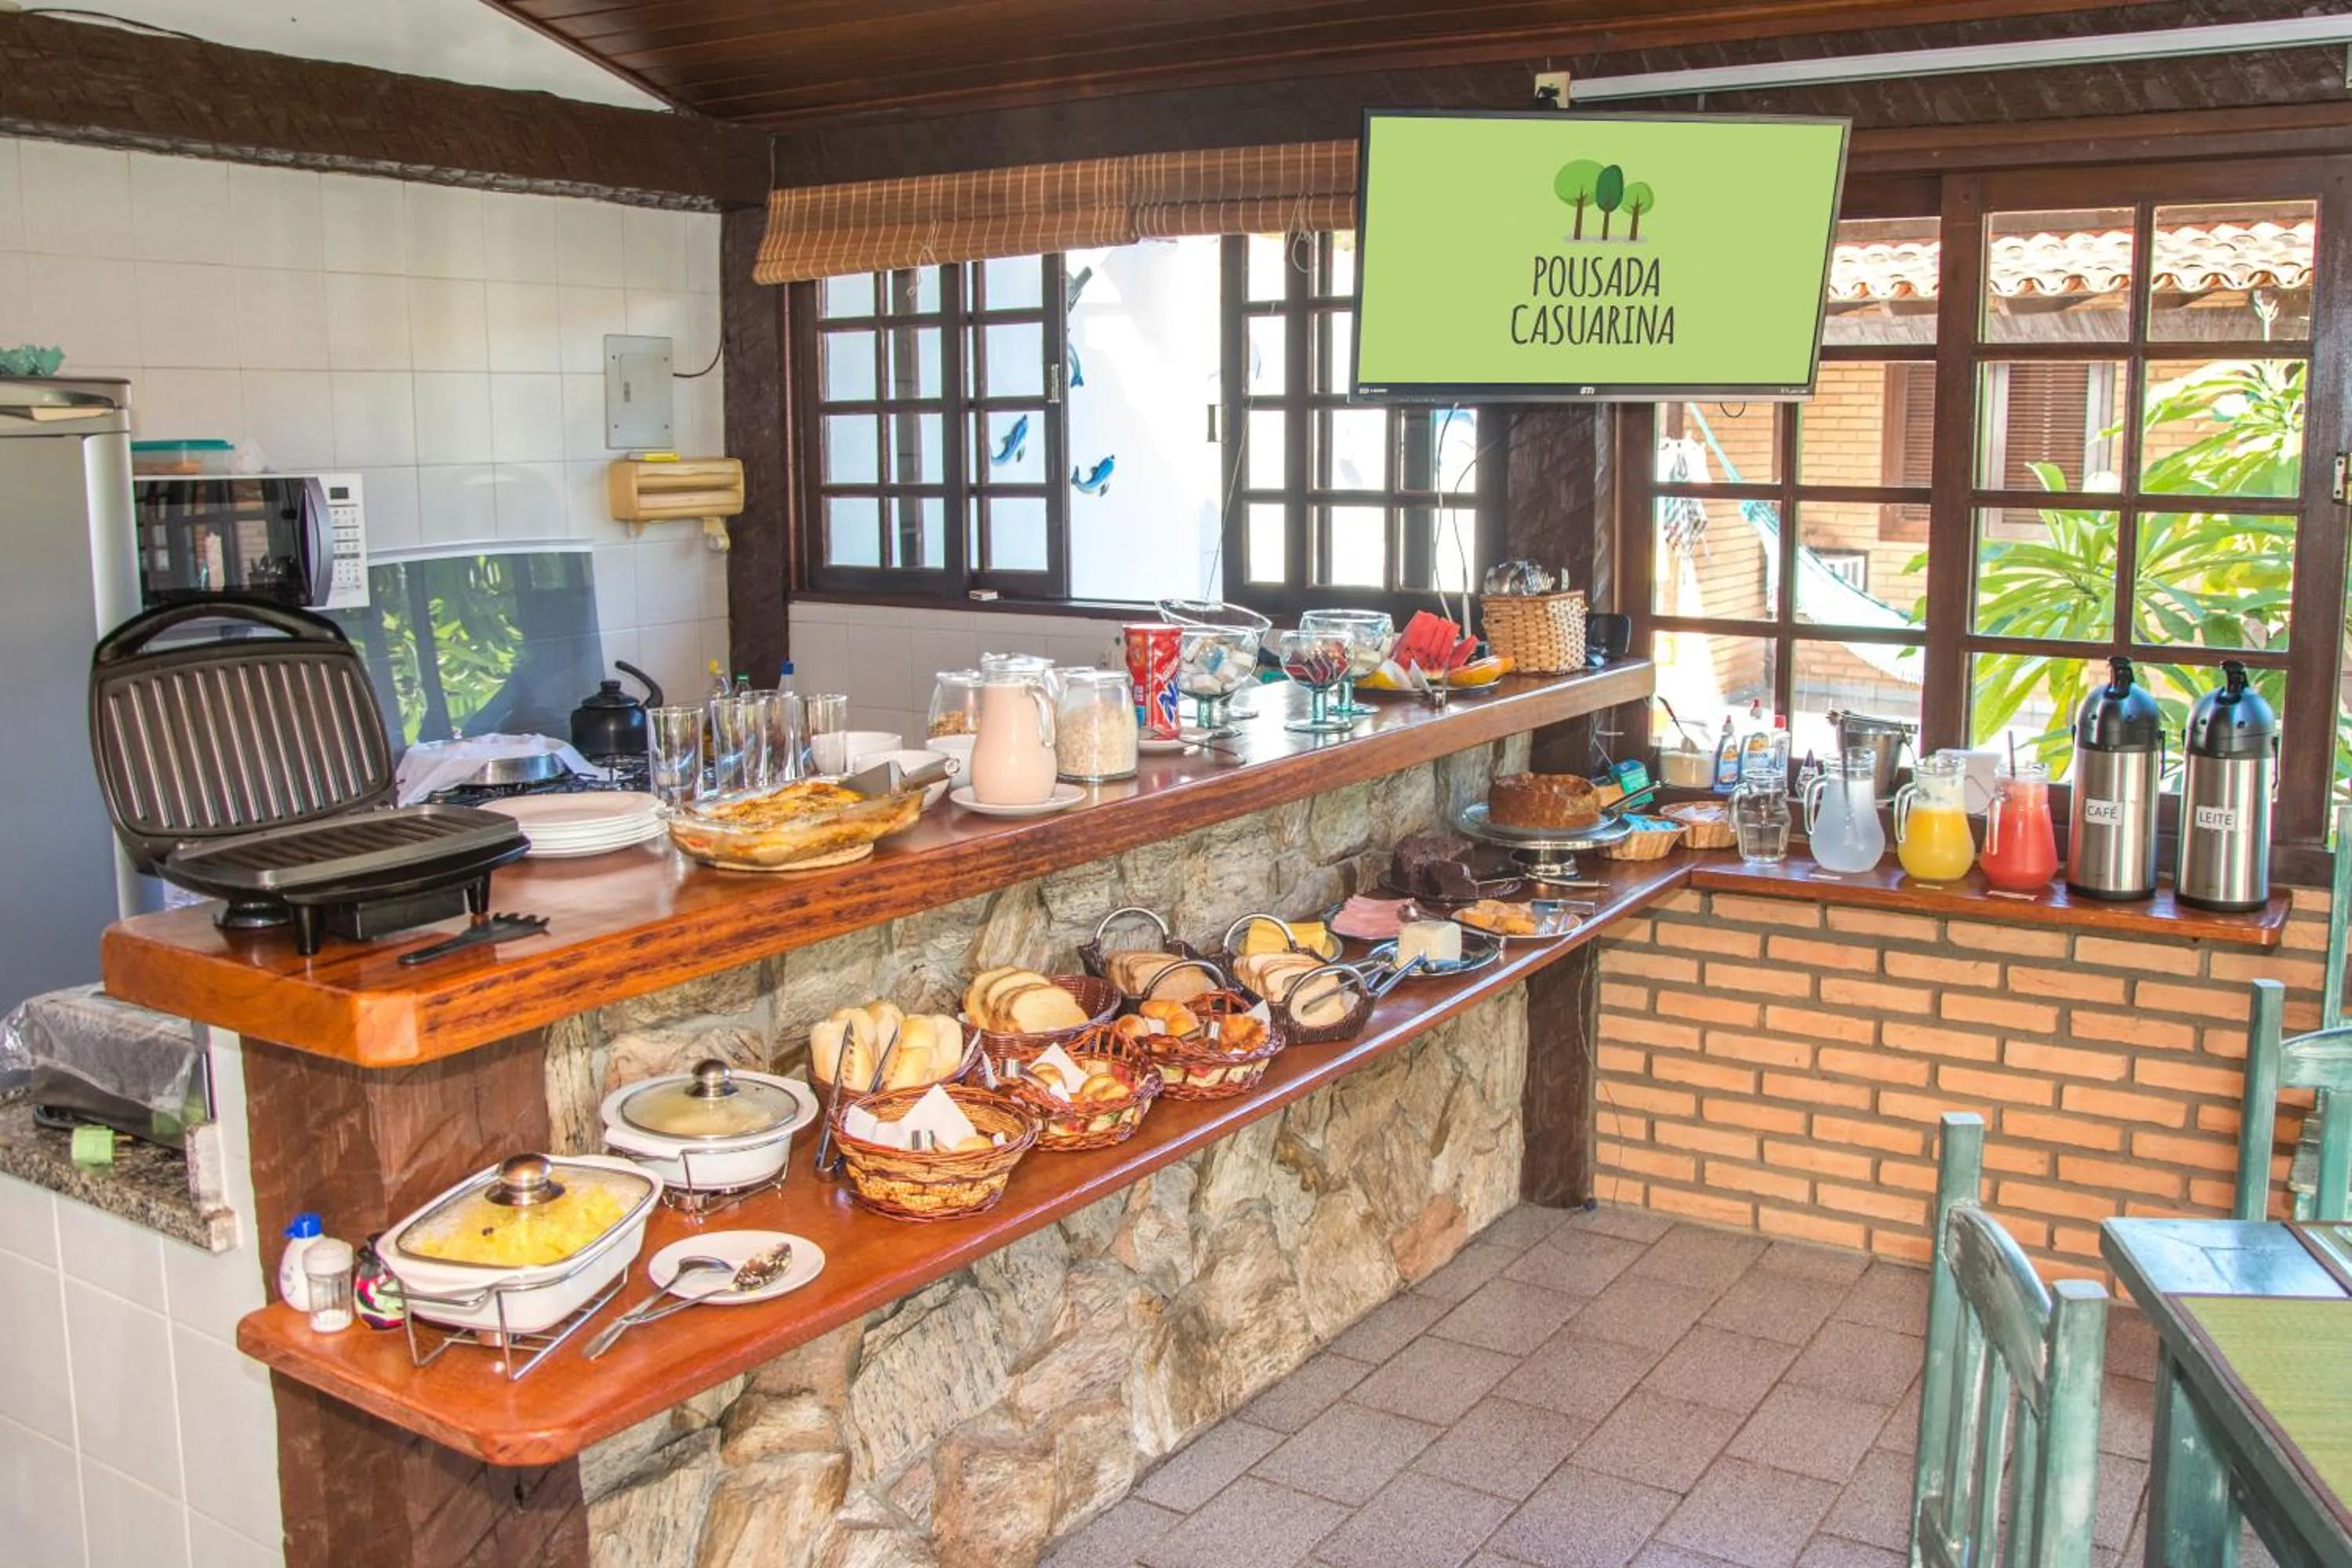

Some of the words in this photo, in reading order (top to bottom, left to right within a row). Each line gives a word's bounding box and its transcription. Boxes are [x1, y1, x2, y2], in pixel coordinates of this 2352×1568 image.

[1533, 255, 1660, 298] POUSADA
[1511, 303, 1675, 346] CASUARINA
[2086, 805, 2118, 819] CAFÉ
[2199, 811, 2233, 826] LEITE
